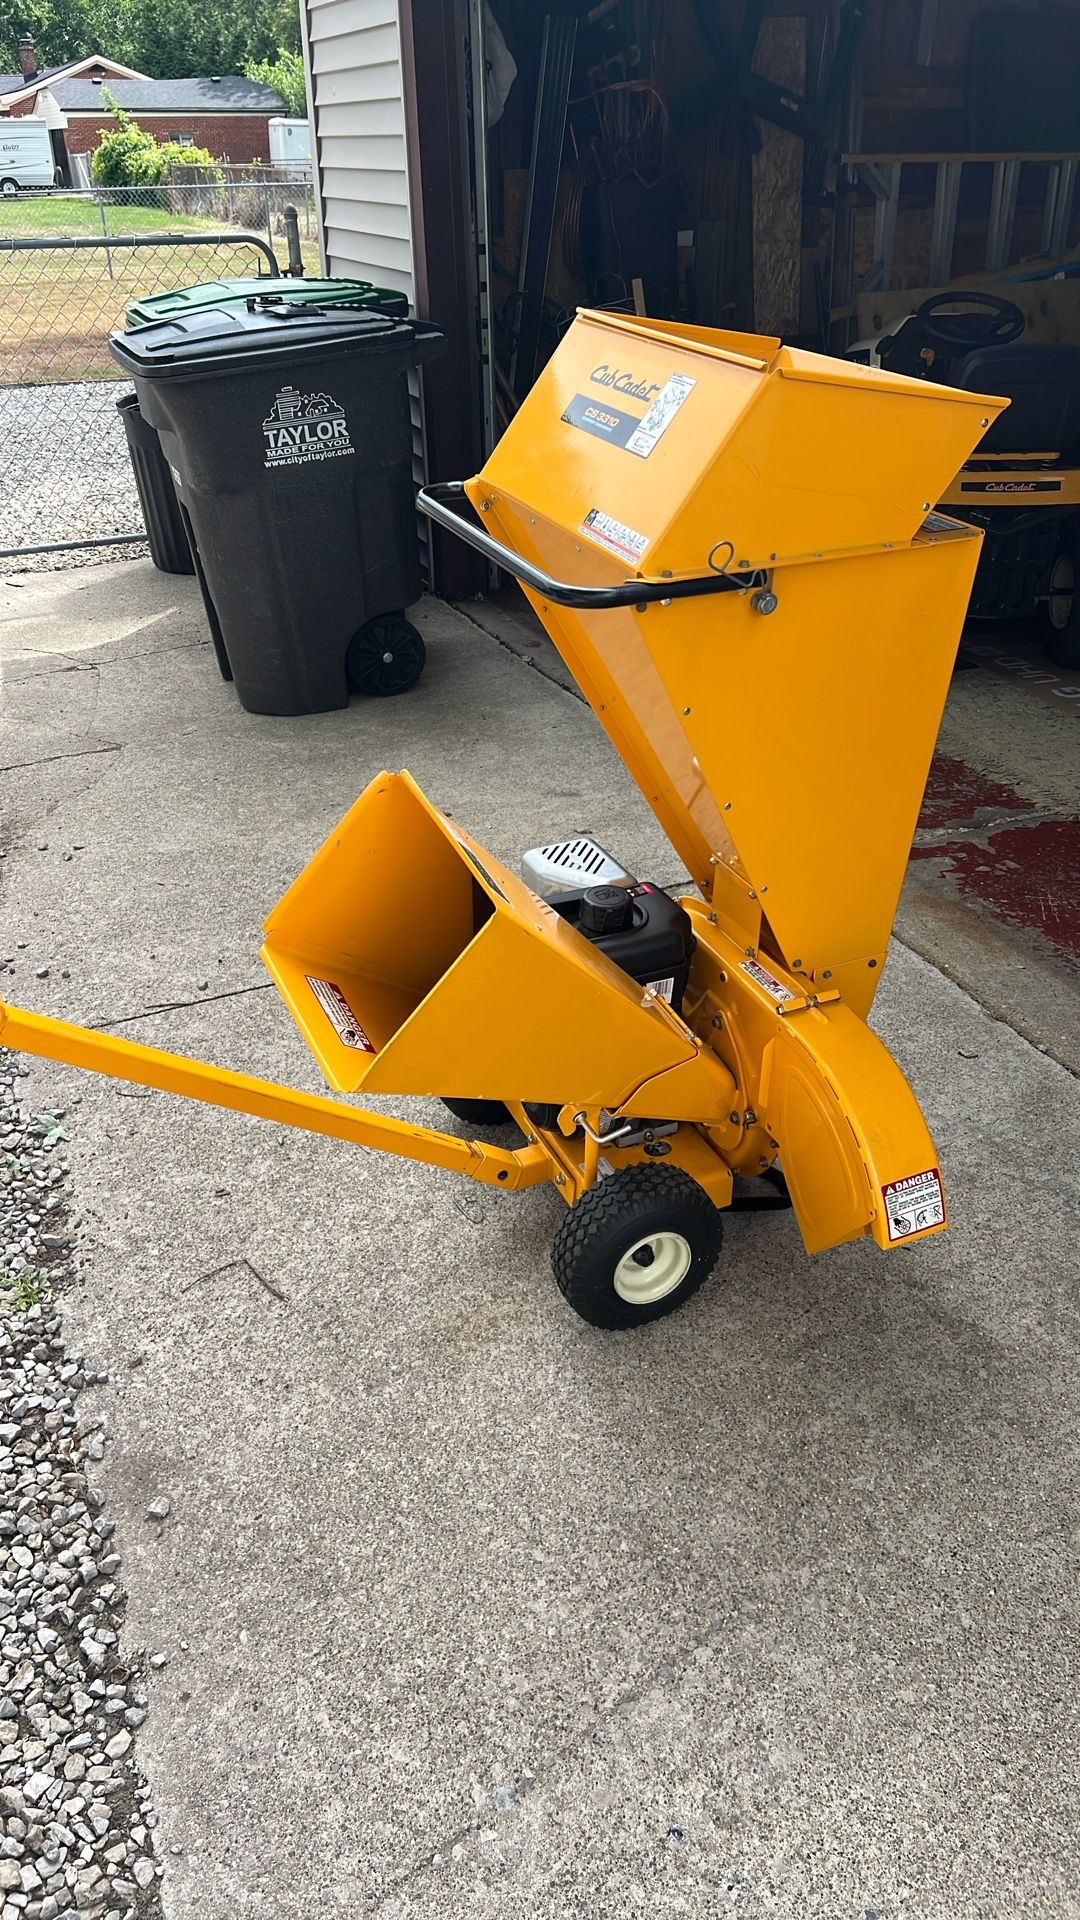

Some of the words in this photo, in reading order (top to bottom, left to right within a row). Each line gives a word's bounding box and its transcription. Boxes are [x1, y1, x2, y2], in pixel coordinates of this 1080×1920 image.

[589, 365, 620, 387] Cub
[612, 373, 661, 402] Cadet
[263, 419, 349, 448] TAYLOR
[263, 447, 355, 468] www.cityoftaylor.com
[267, 446, 299, 458] MADE
[301, 442, 324, 452] FOR
[326, 438, 349, 448] YOU
[985, 483, 1004, 491] Cub
[1005, 483, 1037, 491] Cadet
[340, 1002, 370, 1046] DANGER
[895, 1171, 934, 1191] DANGER
